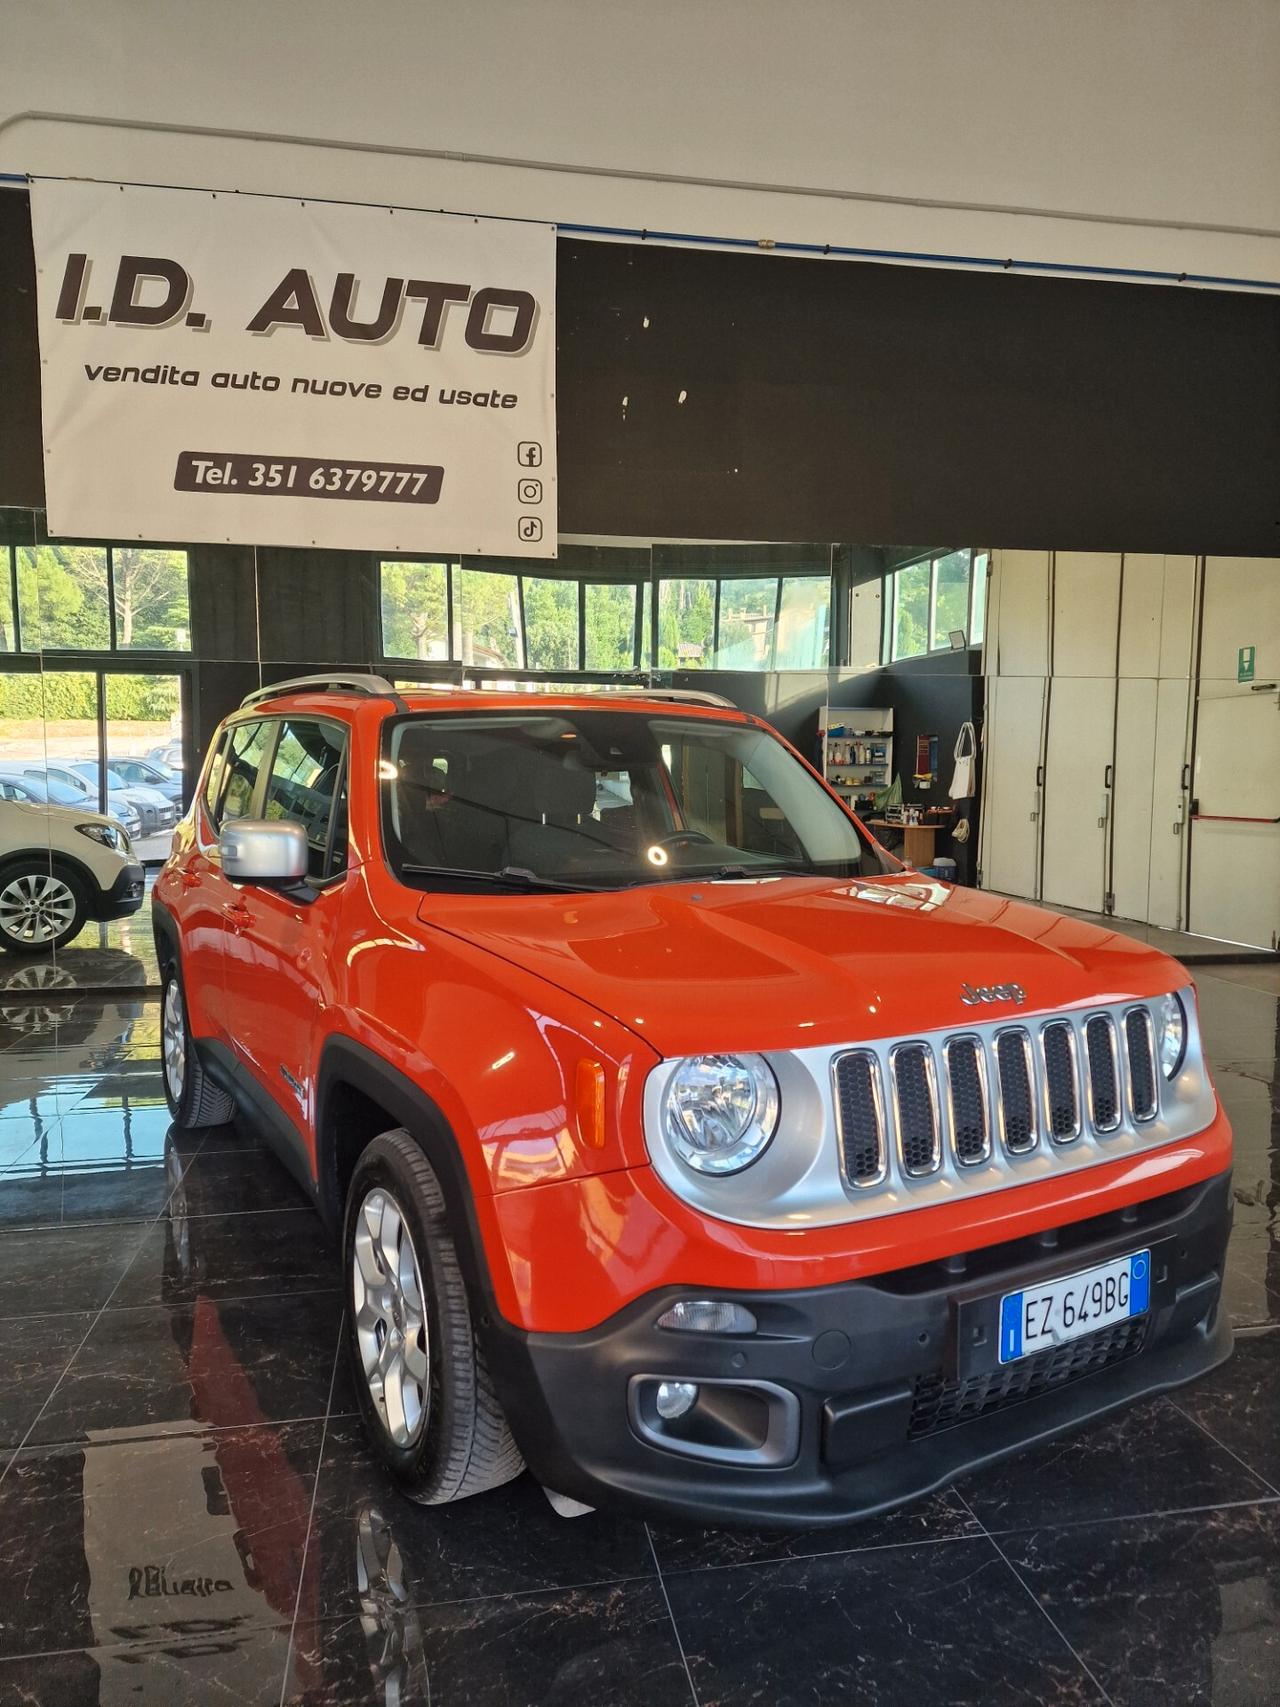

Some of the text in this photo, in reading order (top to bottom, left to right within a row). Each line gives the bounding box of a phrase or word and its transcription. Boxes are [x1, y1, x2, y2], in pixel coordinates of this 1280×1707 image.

[55, 253, 541, 357] I.D. AUTO
[84, 363, 518, 409] vendita auto nuove ed usate
[191, 460, 428, 496] Tel. 351 6379777
[960, 983, 1026, 1005] Jeep
[1025, 1272, 1129, 1340] EZ 649BG
